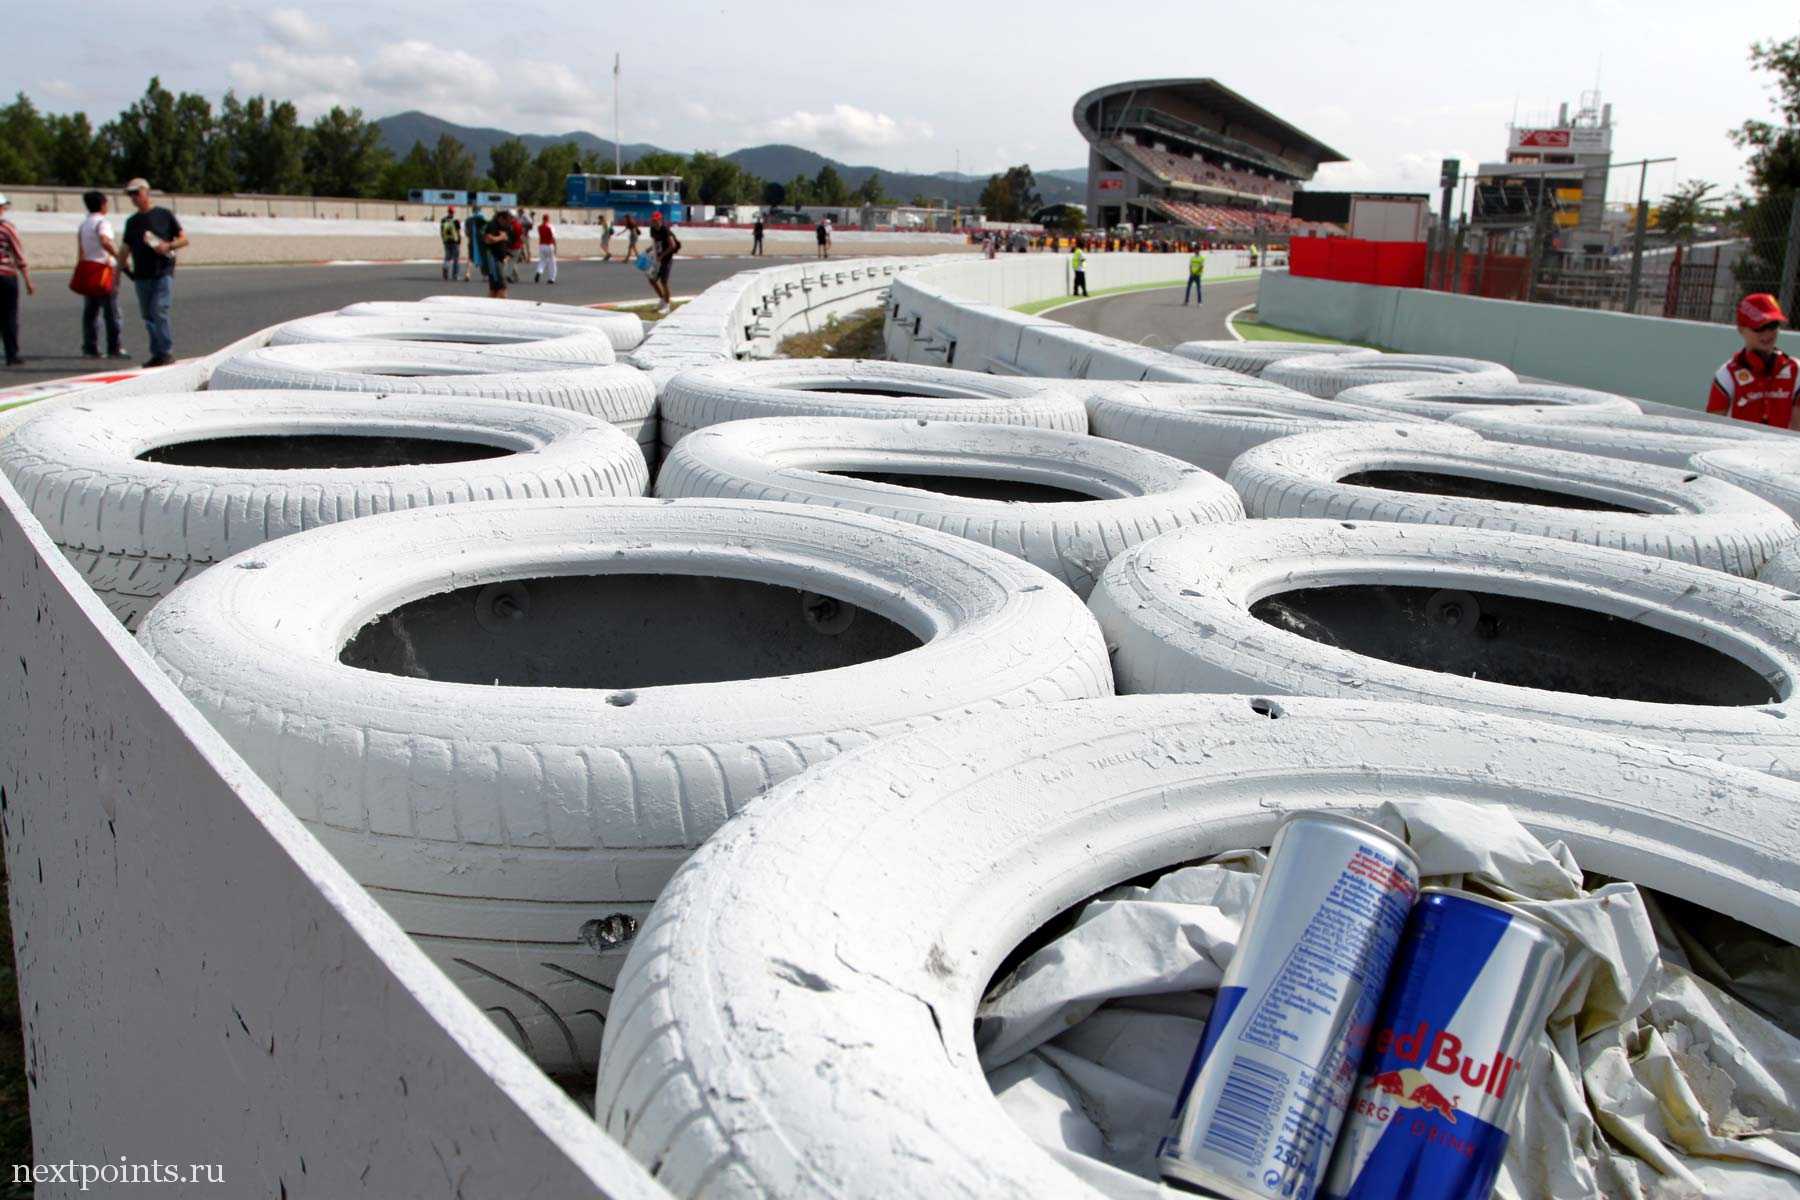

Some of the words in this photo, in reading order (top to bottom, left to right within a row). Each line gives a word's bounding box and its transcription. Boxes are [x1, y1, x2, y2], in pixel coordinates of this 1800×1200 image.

[1375, 1021, 1429, 1063] ed
[1425, 1030, 1514, 1100] Bull
[1273, 1144, 1299, 1169] 250
